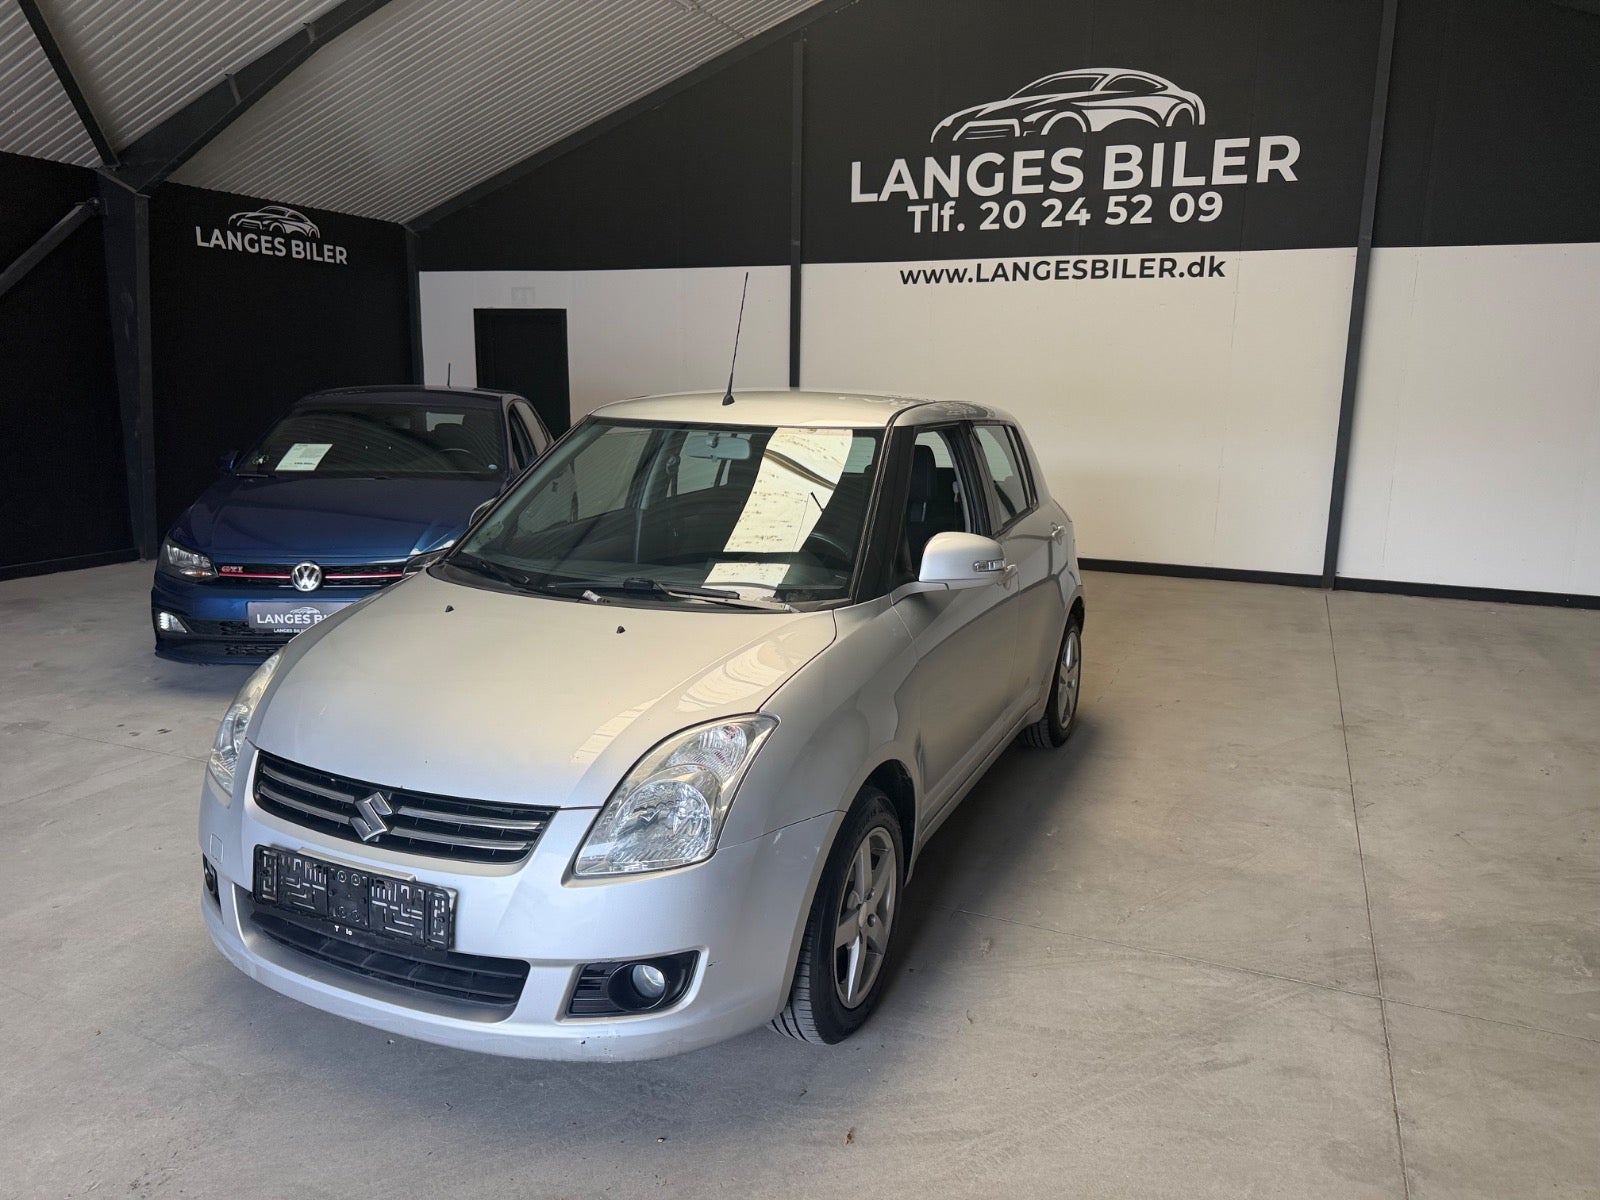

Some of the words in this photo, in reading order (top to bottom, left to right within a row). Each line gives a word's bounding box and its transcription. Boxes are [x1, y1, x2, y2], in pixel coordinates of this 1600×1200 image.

[850, 147, 1084, 203] LANGES
[1102, 135, 1301, 191] BILER
[907, 200, 966, 234] Tlf.
[979, 199, 1027, 231] 20
[1041, 196, 1092, 228] 24
[1104, 193, 1153, 226] 52
[1169, 190, 1223, 224] 09
[195, 226, 287, 257] LANGES
[291, 239, 348, 265] BILER
[899, 255, 1226, 285] www.LANGESBILER.dk
[221, 565, 243, 573] GTI
[256, 613, 311, 624] LANGES
